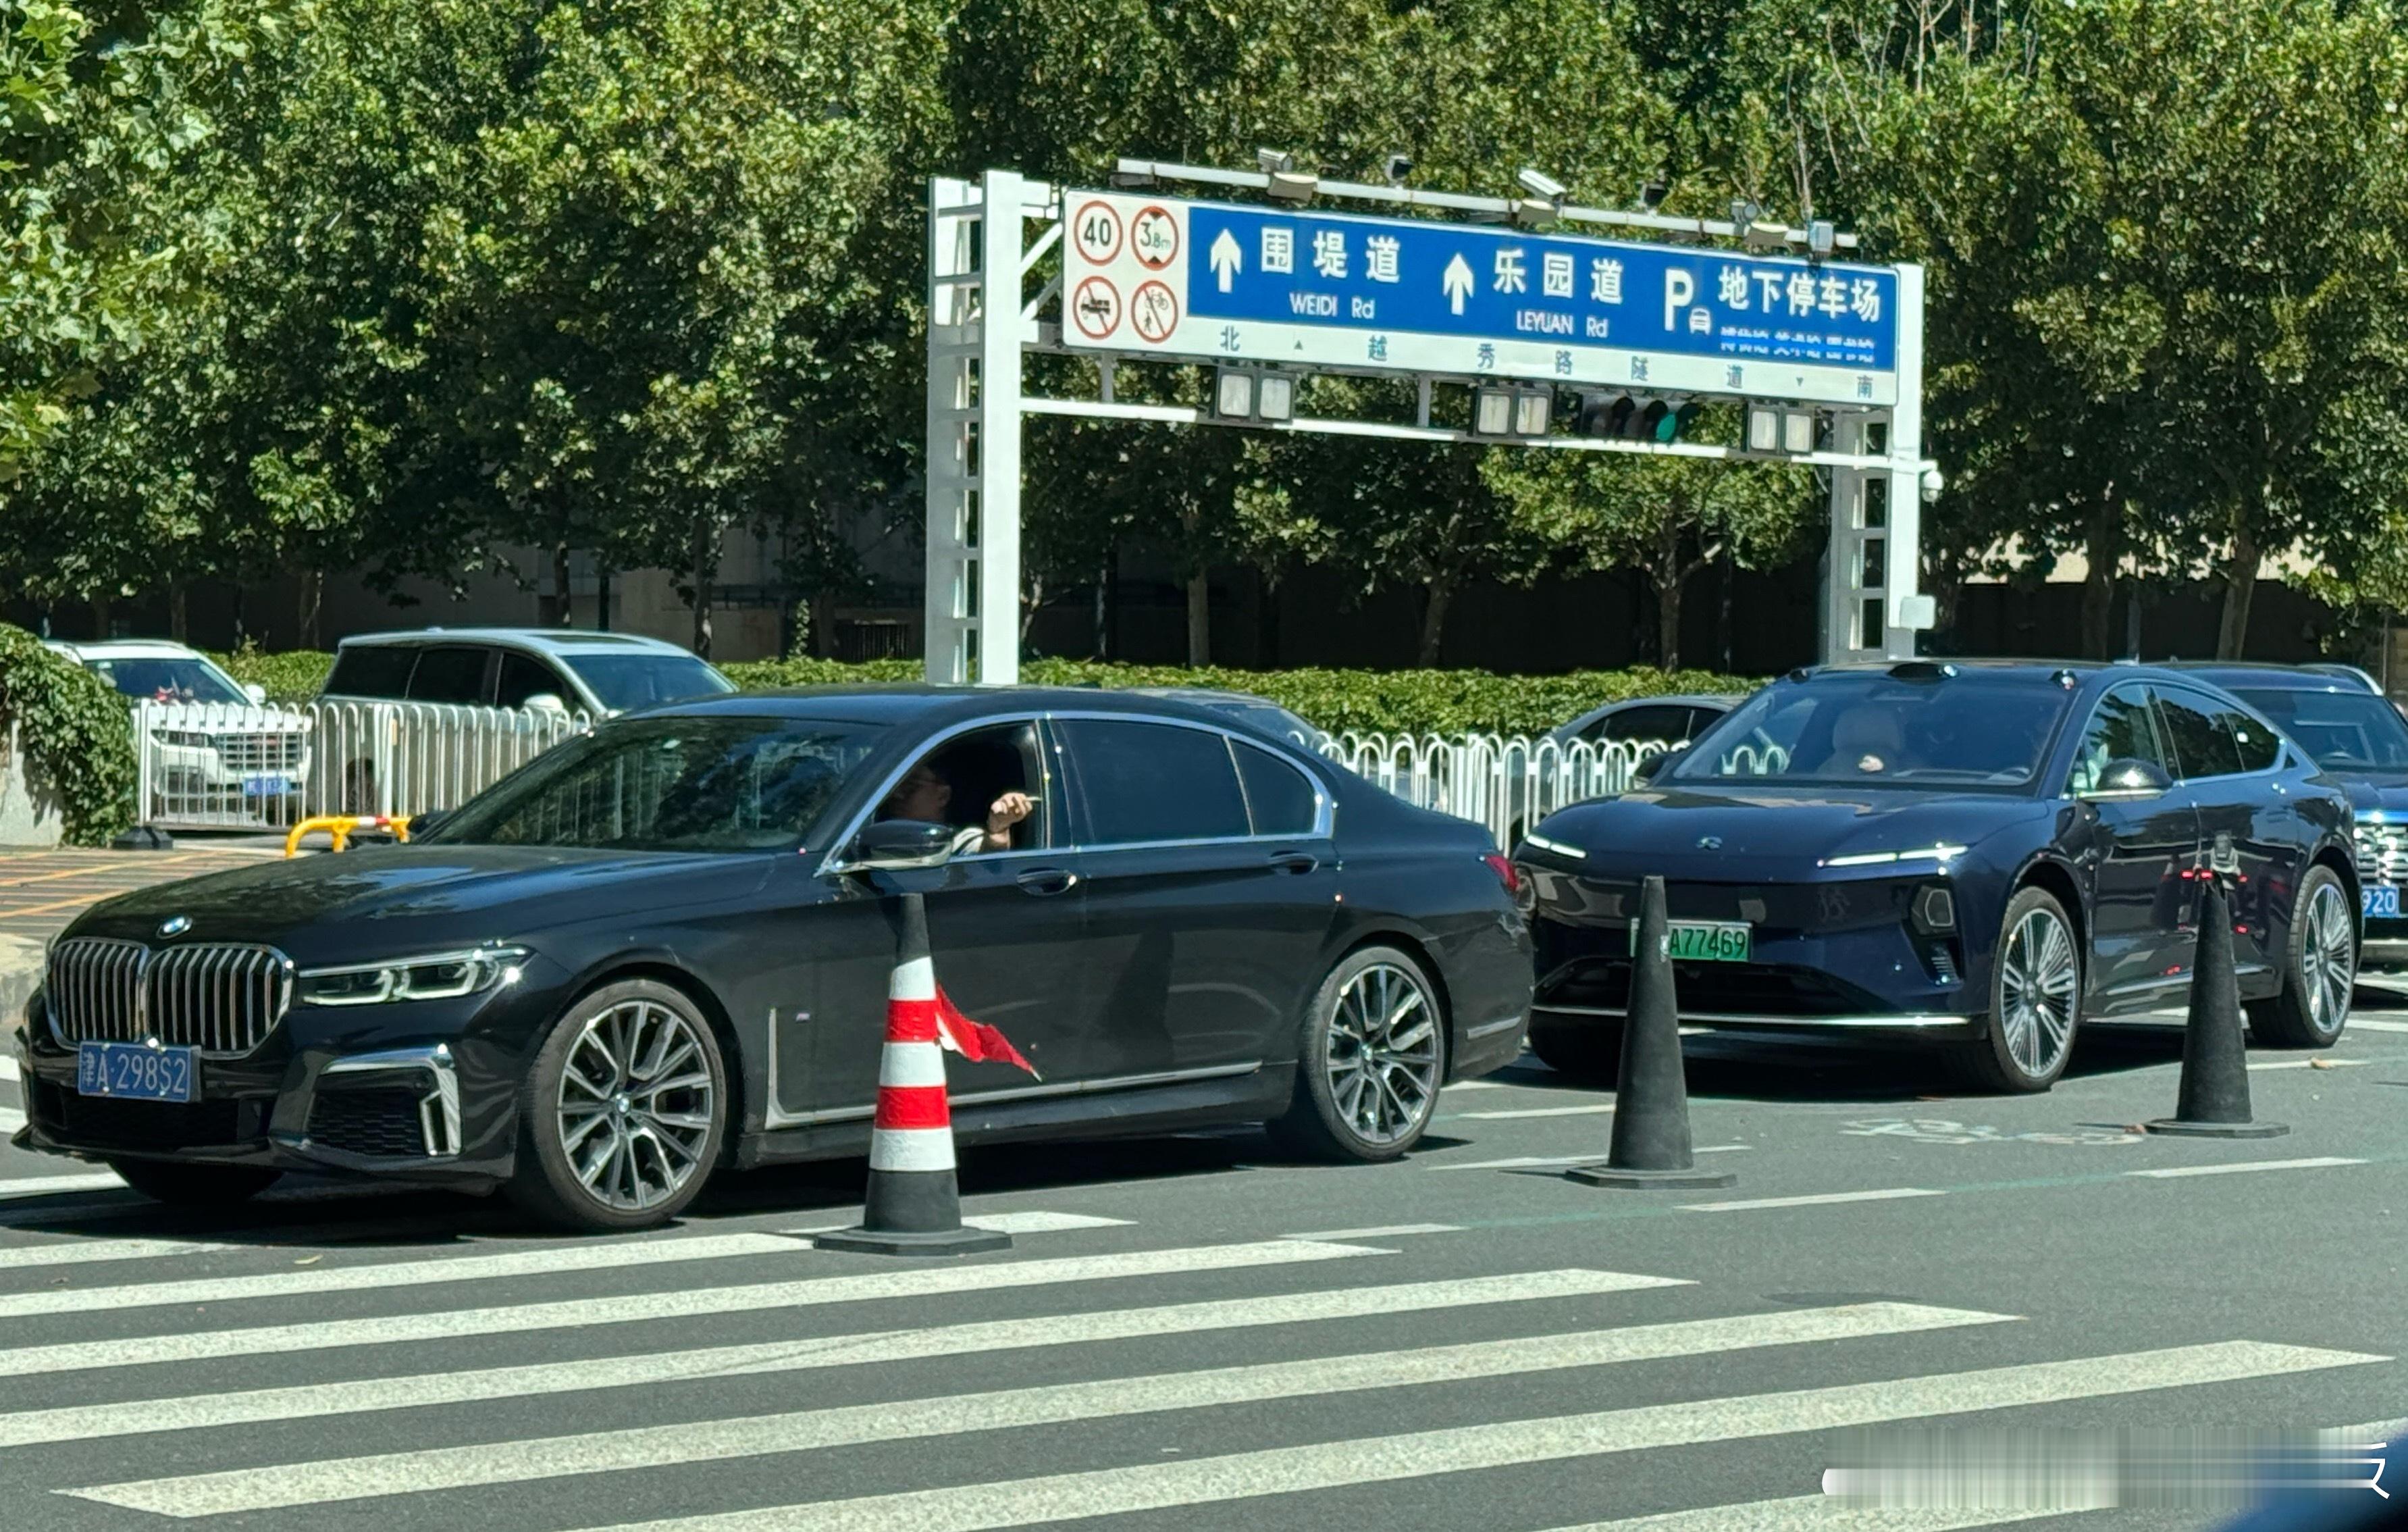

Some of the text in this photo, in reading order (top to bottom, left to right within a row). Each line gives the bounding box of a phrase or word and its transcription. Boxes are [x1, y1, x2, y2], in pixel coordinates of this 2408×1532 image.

[1083, 215, 1111, 247] 40
[1261, 226, 1401, 284] 围堤道
[1492, 248, 1623, 305] 乐园道
[1664, 267, 1694, 332] P
[1718, 265, 1881, 323] 地下停车场
[1289, 292, 1375, 320] WEIDI Rd
[1516, 310, 1609, 338] LEYUAN Rd
[1220, 325, 1240, 352] 北
[1856, 374, 1874, 399] 南
[1669, 927, 1747, 959] A77469
